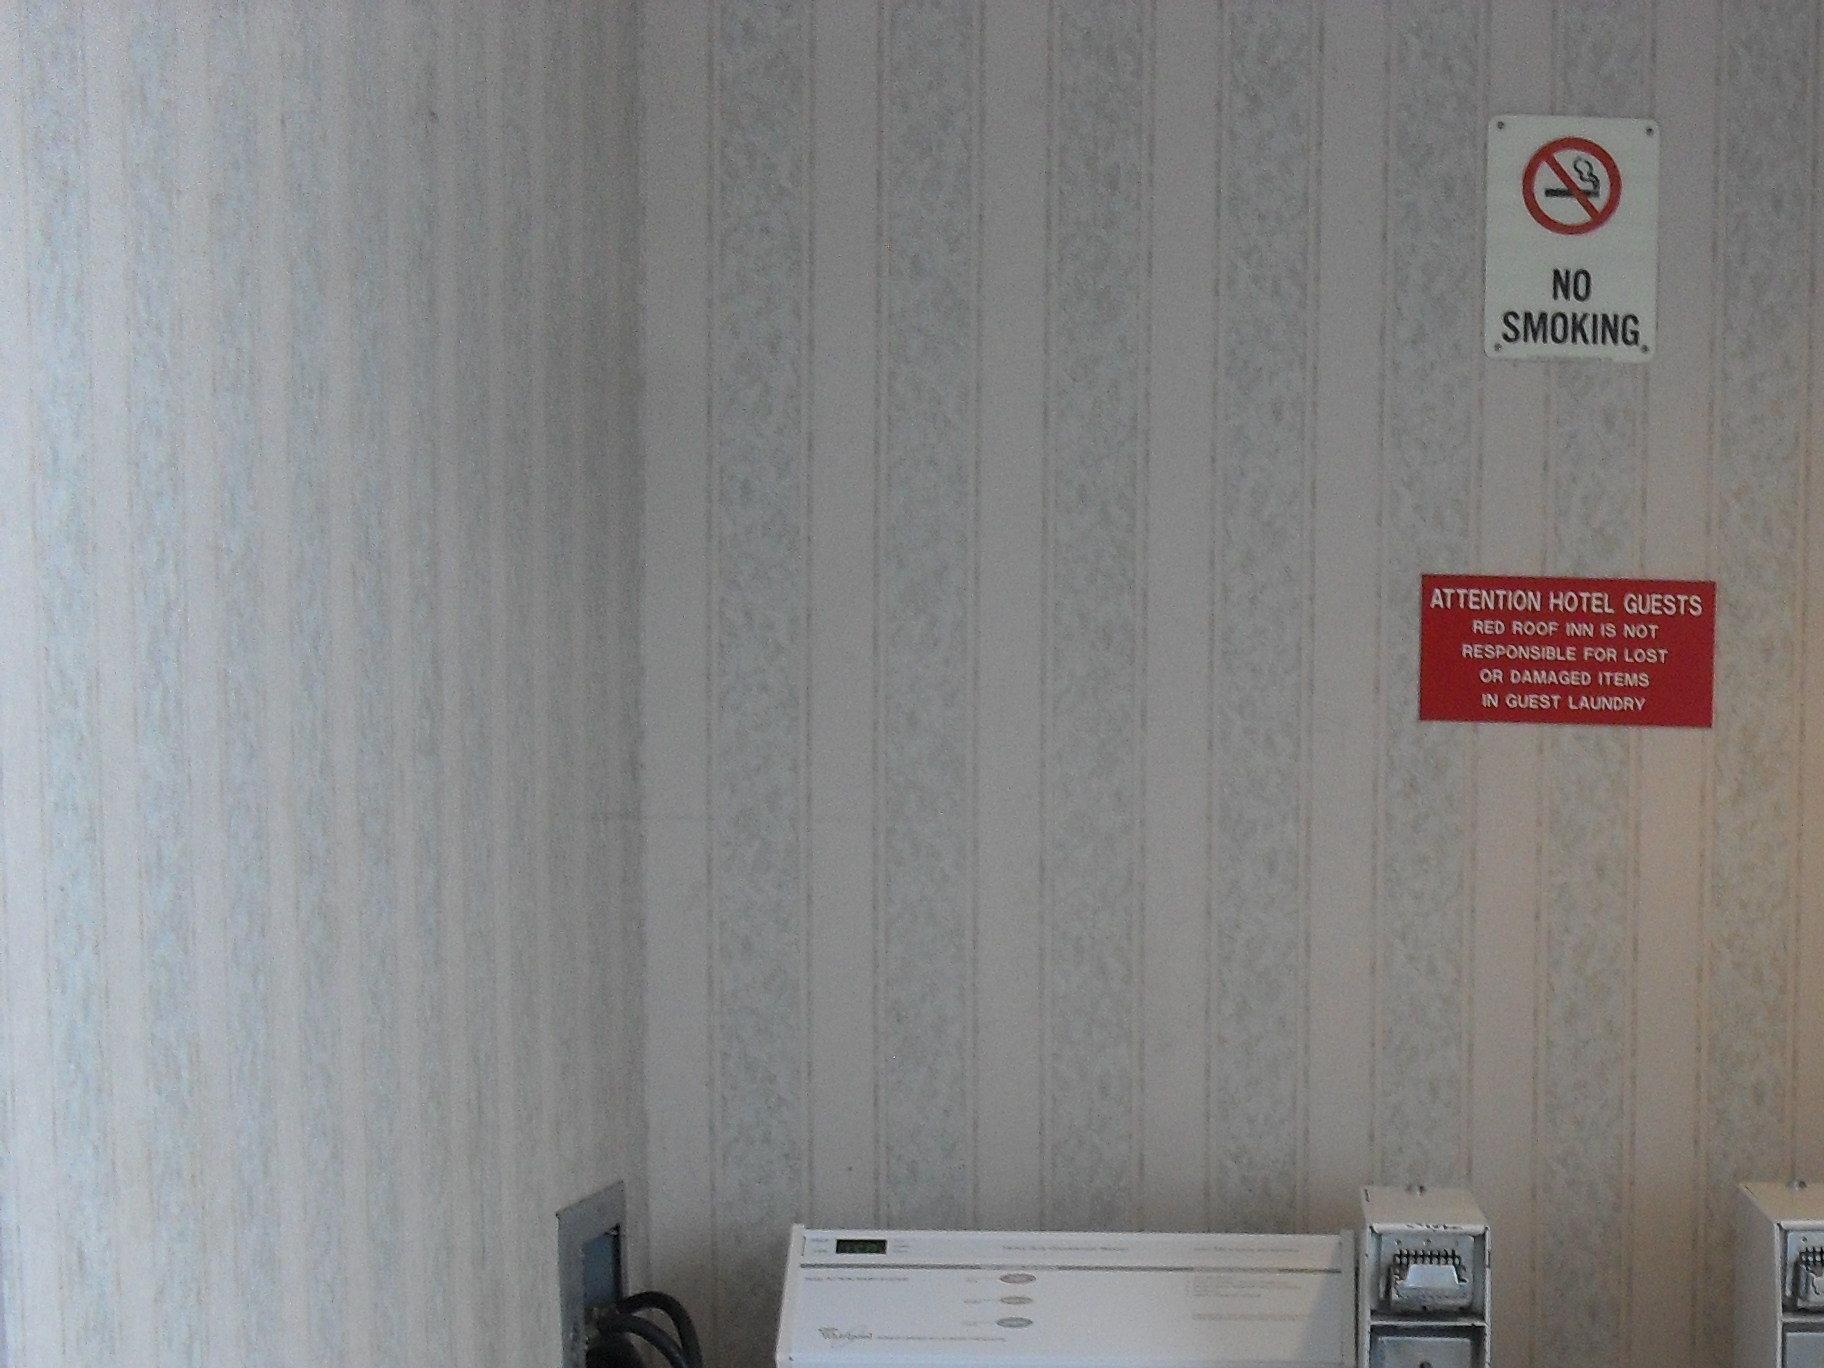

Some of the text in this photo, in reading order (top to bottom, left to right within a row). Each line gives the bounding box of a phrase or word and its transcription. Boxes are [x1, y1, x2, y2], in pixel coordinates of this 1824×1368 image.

[1552, 268, 1593, 302] NO
[1501, 310, 1641, 347] SMOKING
[1430, 588, 1703, 617] ATTENTION HOTEL GUESTS
[1472, 619, 1659, 640] RED ROOF INN IS NOT
[1461, 644, 1669, 664] RESPONSIBLE FOR LOST
[1479, 668, 1650, 687] OR DAMAGED ITEMS
[1481, 693, 1646, 712] IN GUEST LAUNDRY
